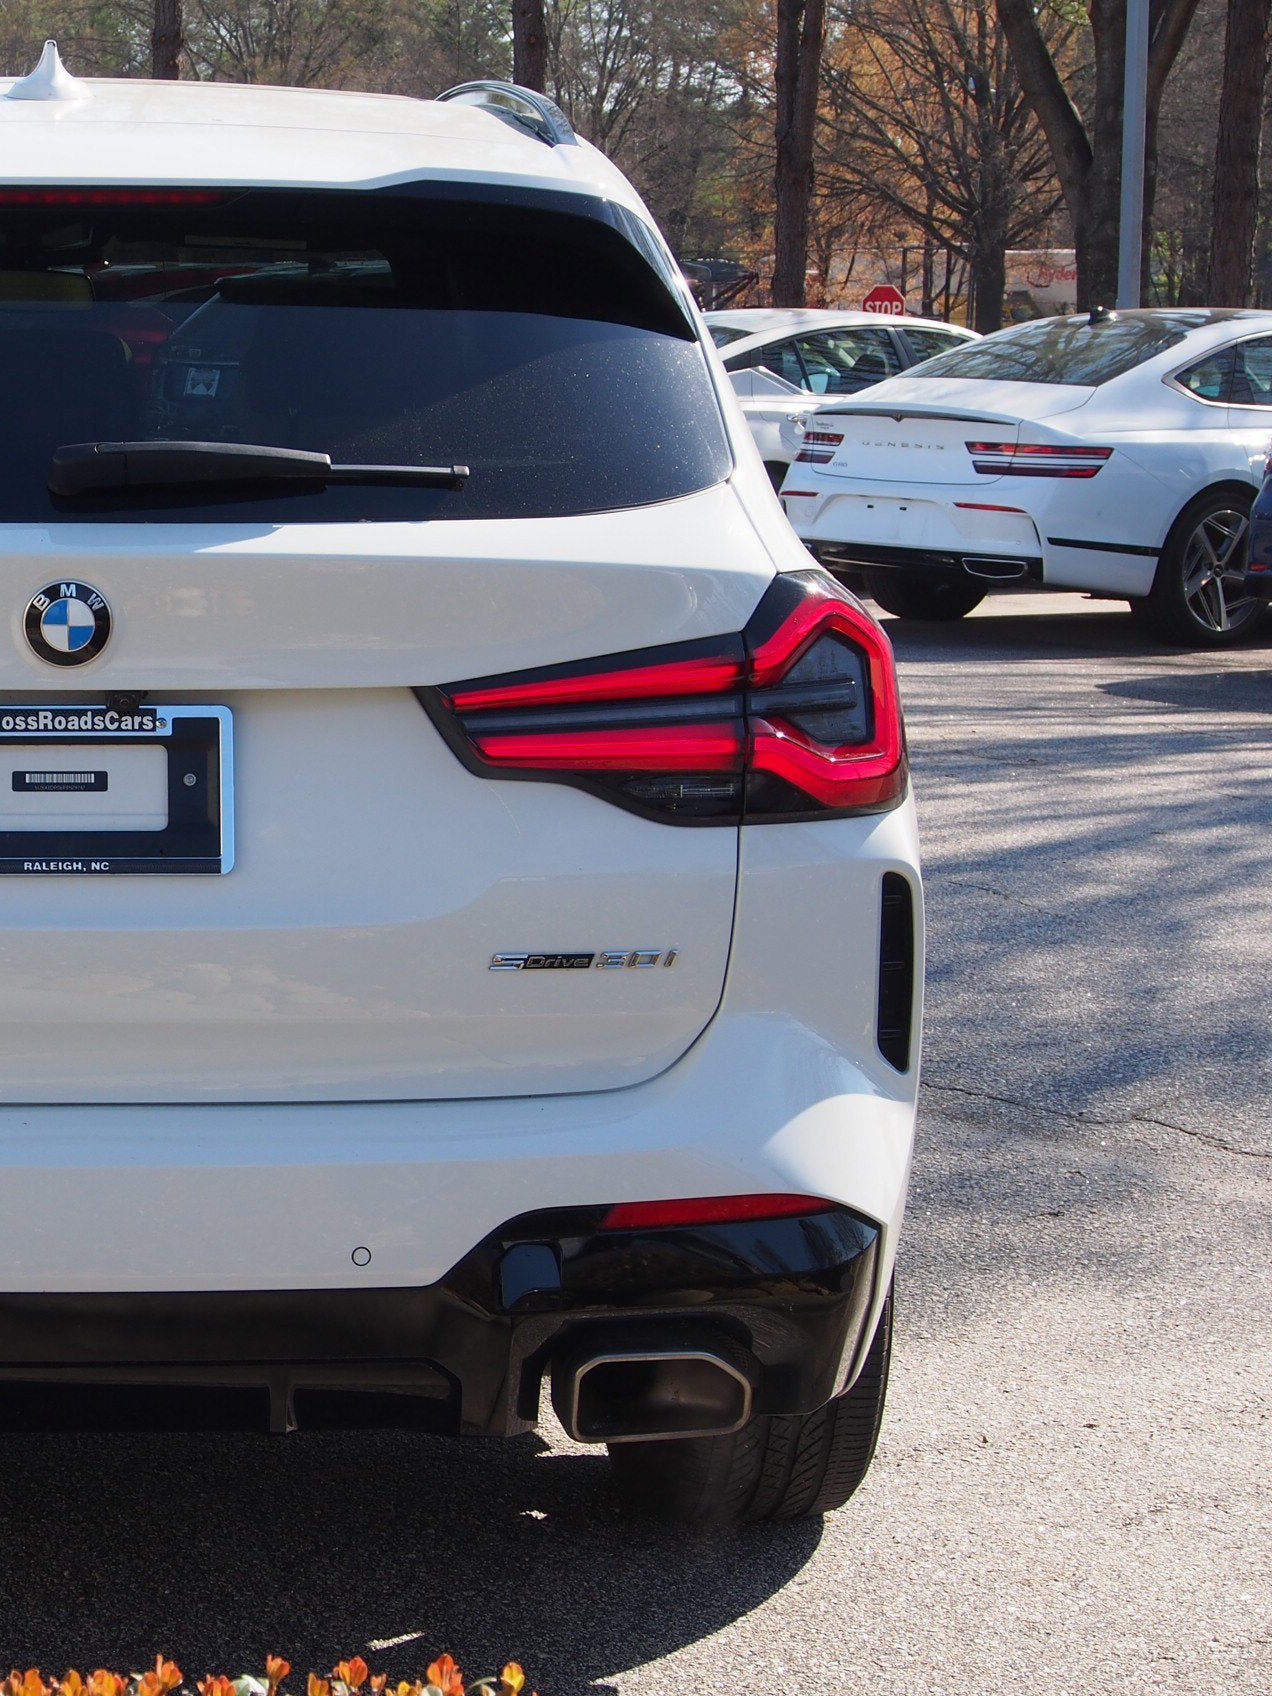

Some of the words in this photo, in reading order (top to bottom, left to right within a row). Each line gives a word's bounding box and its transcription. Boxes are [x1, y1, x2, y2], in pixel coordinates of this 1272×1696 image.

[865, 301, 902, 315] STOP
[32, 583, 105, 612] BMW
[23, 861, 87, 872] RALEIGH,
[90, 861, 110, 871] NC
